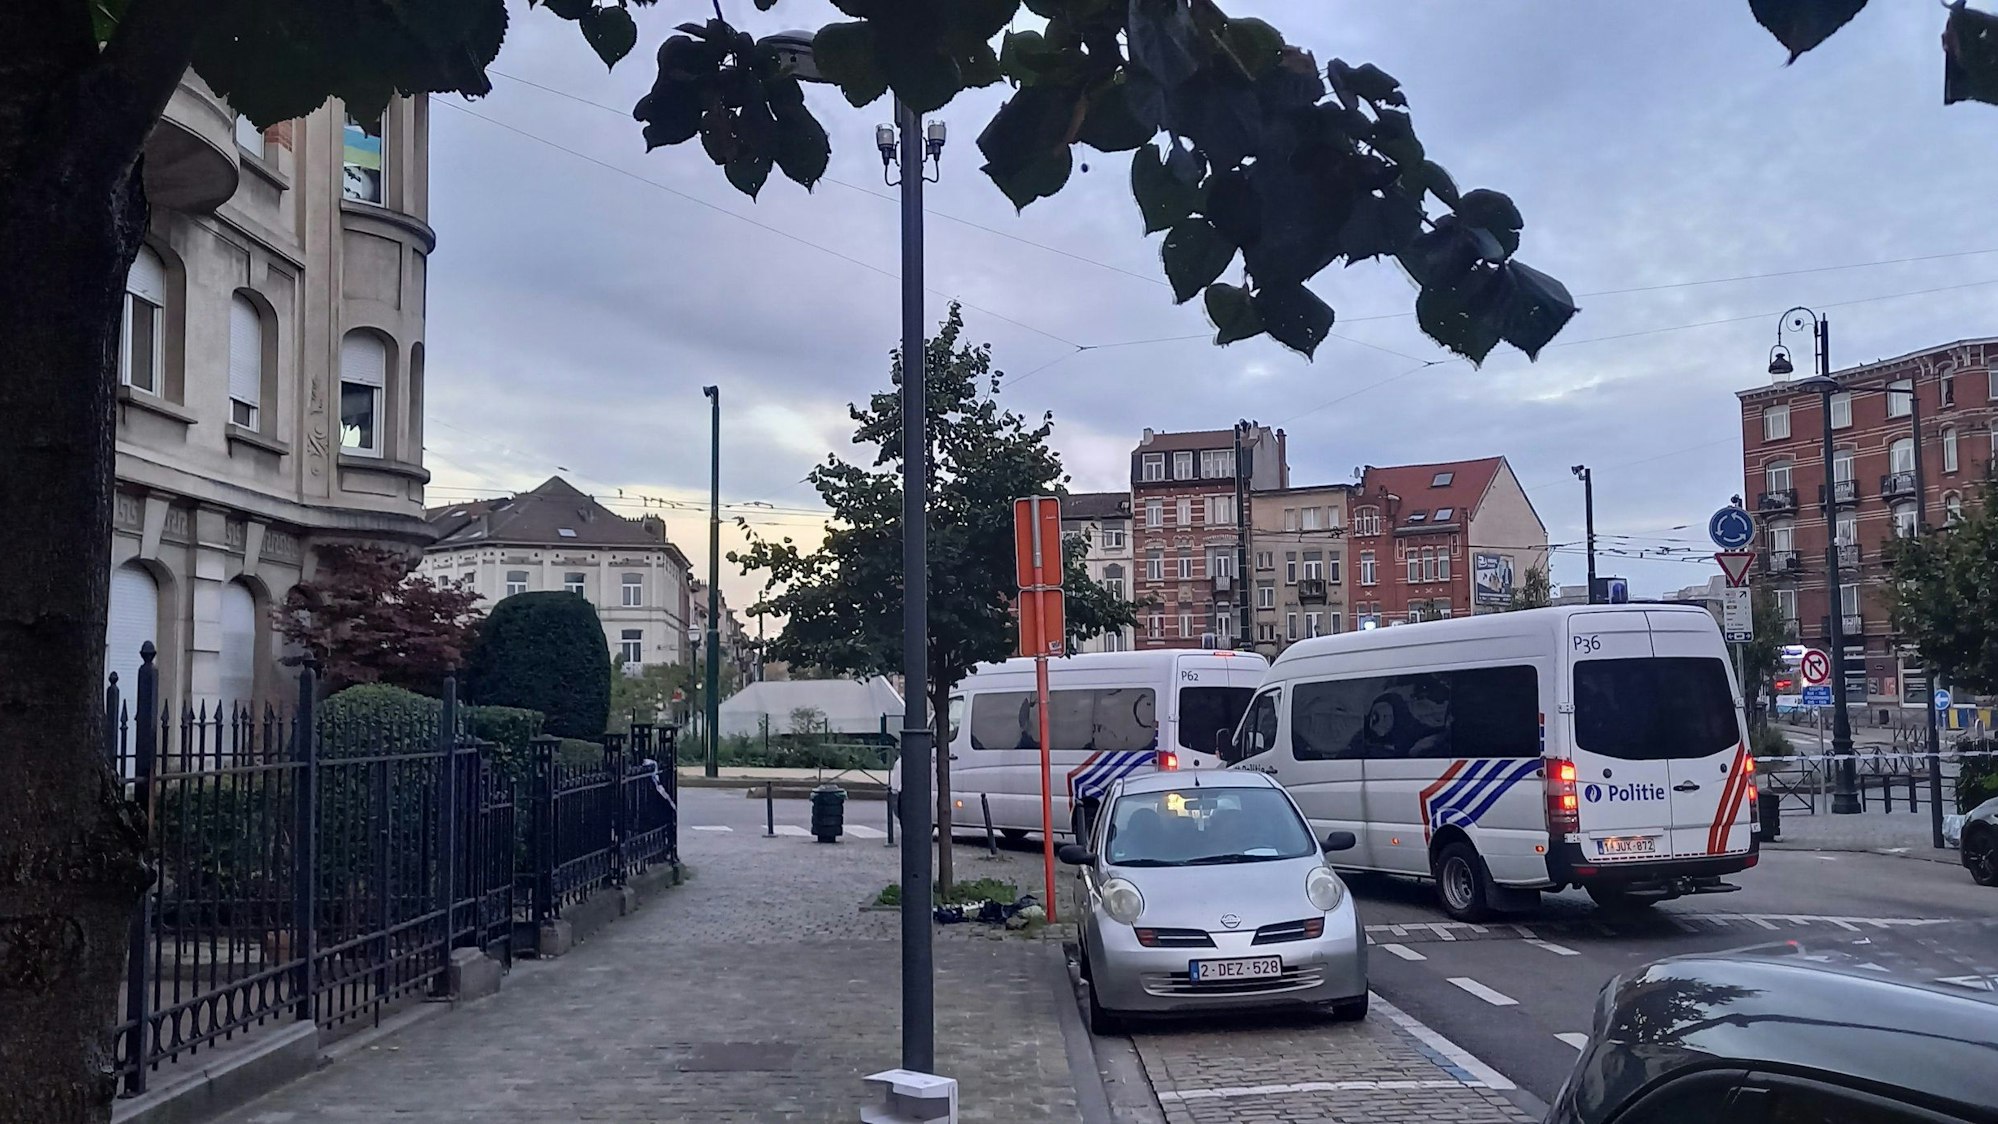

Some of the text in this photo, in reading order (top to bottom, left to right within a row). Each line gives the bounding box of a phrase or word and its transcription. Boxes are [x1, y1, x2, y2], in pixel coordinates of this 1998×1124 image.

[1573, 634, 1601, 655] P36
[1181, 670, 1199, 681] P62
[1608, 783, 1666, 802] Politie
